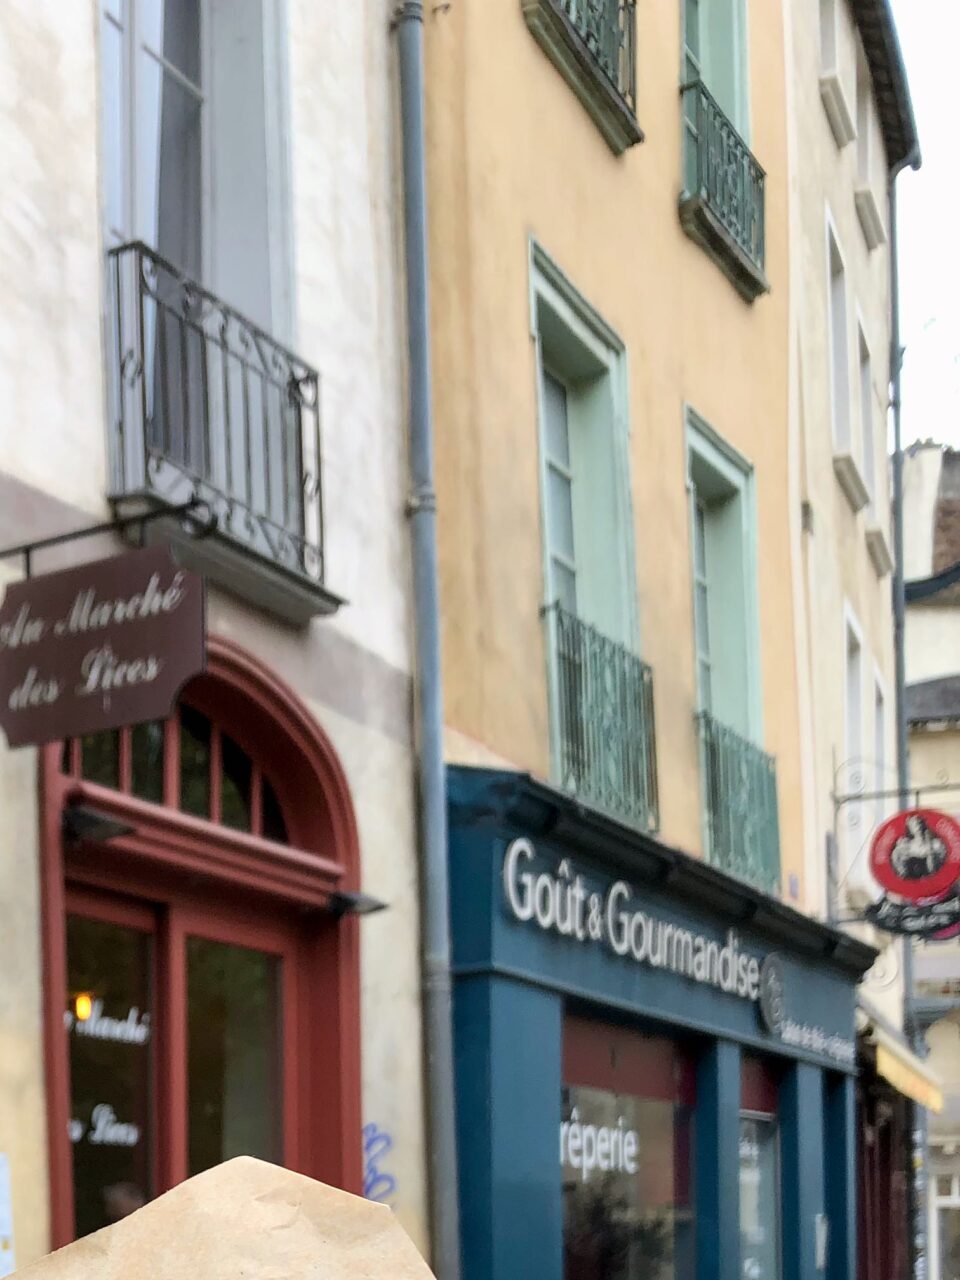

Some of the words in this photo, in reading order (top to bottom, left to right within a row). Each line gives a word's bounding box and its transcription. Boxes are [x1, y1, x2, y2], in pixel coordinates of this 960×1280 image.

[54, 570, 185, 634] Marché
[8, 666, 60, 711] des
[504, 837, 586, 941] Goût
[588, 892, 603, 940] &
[607, 880, 761, 1000] Gourmandise
[560, 1105, 639, 1183] rêperie
